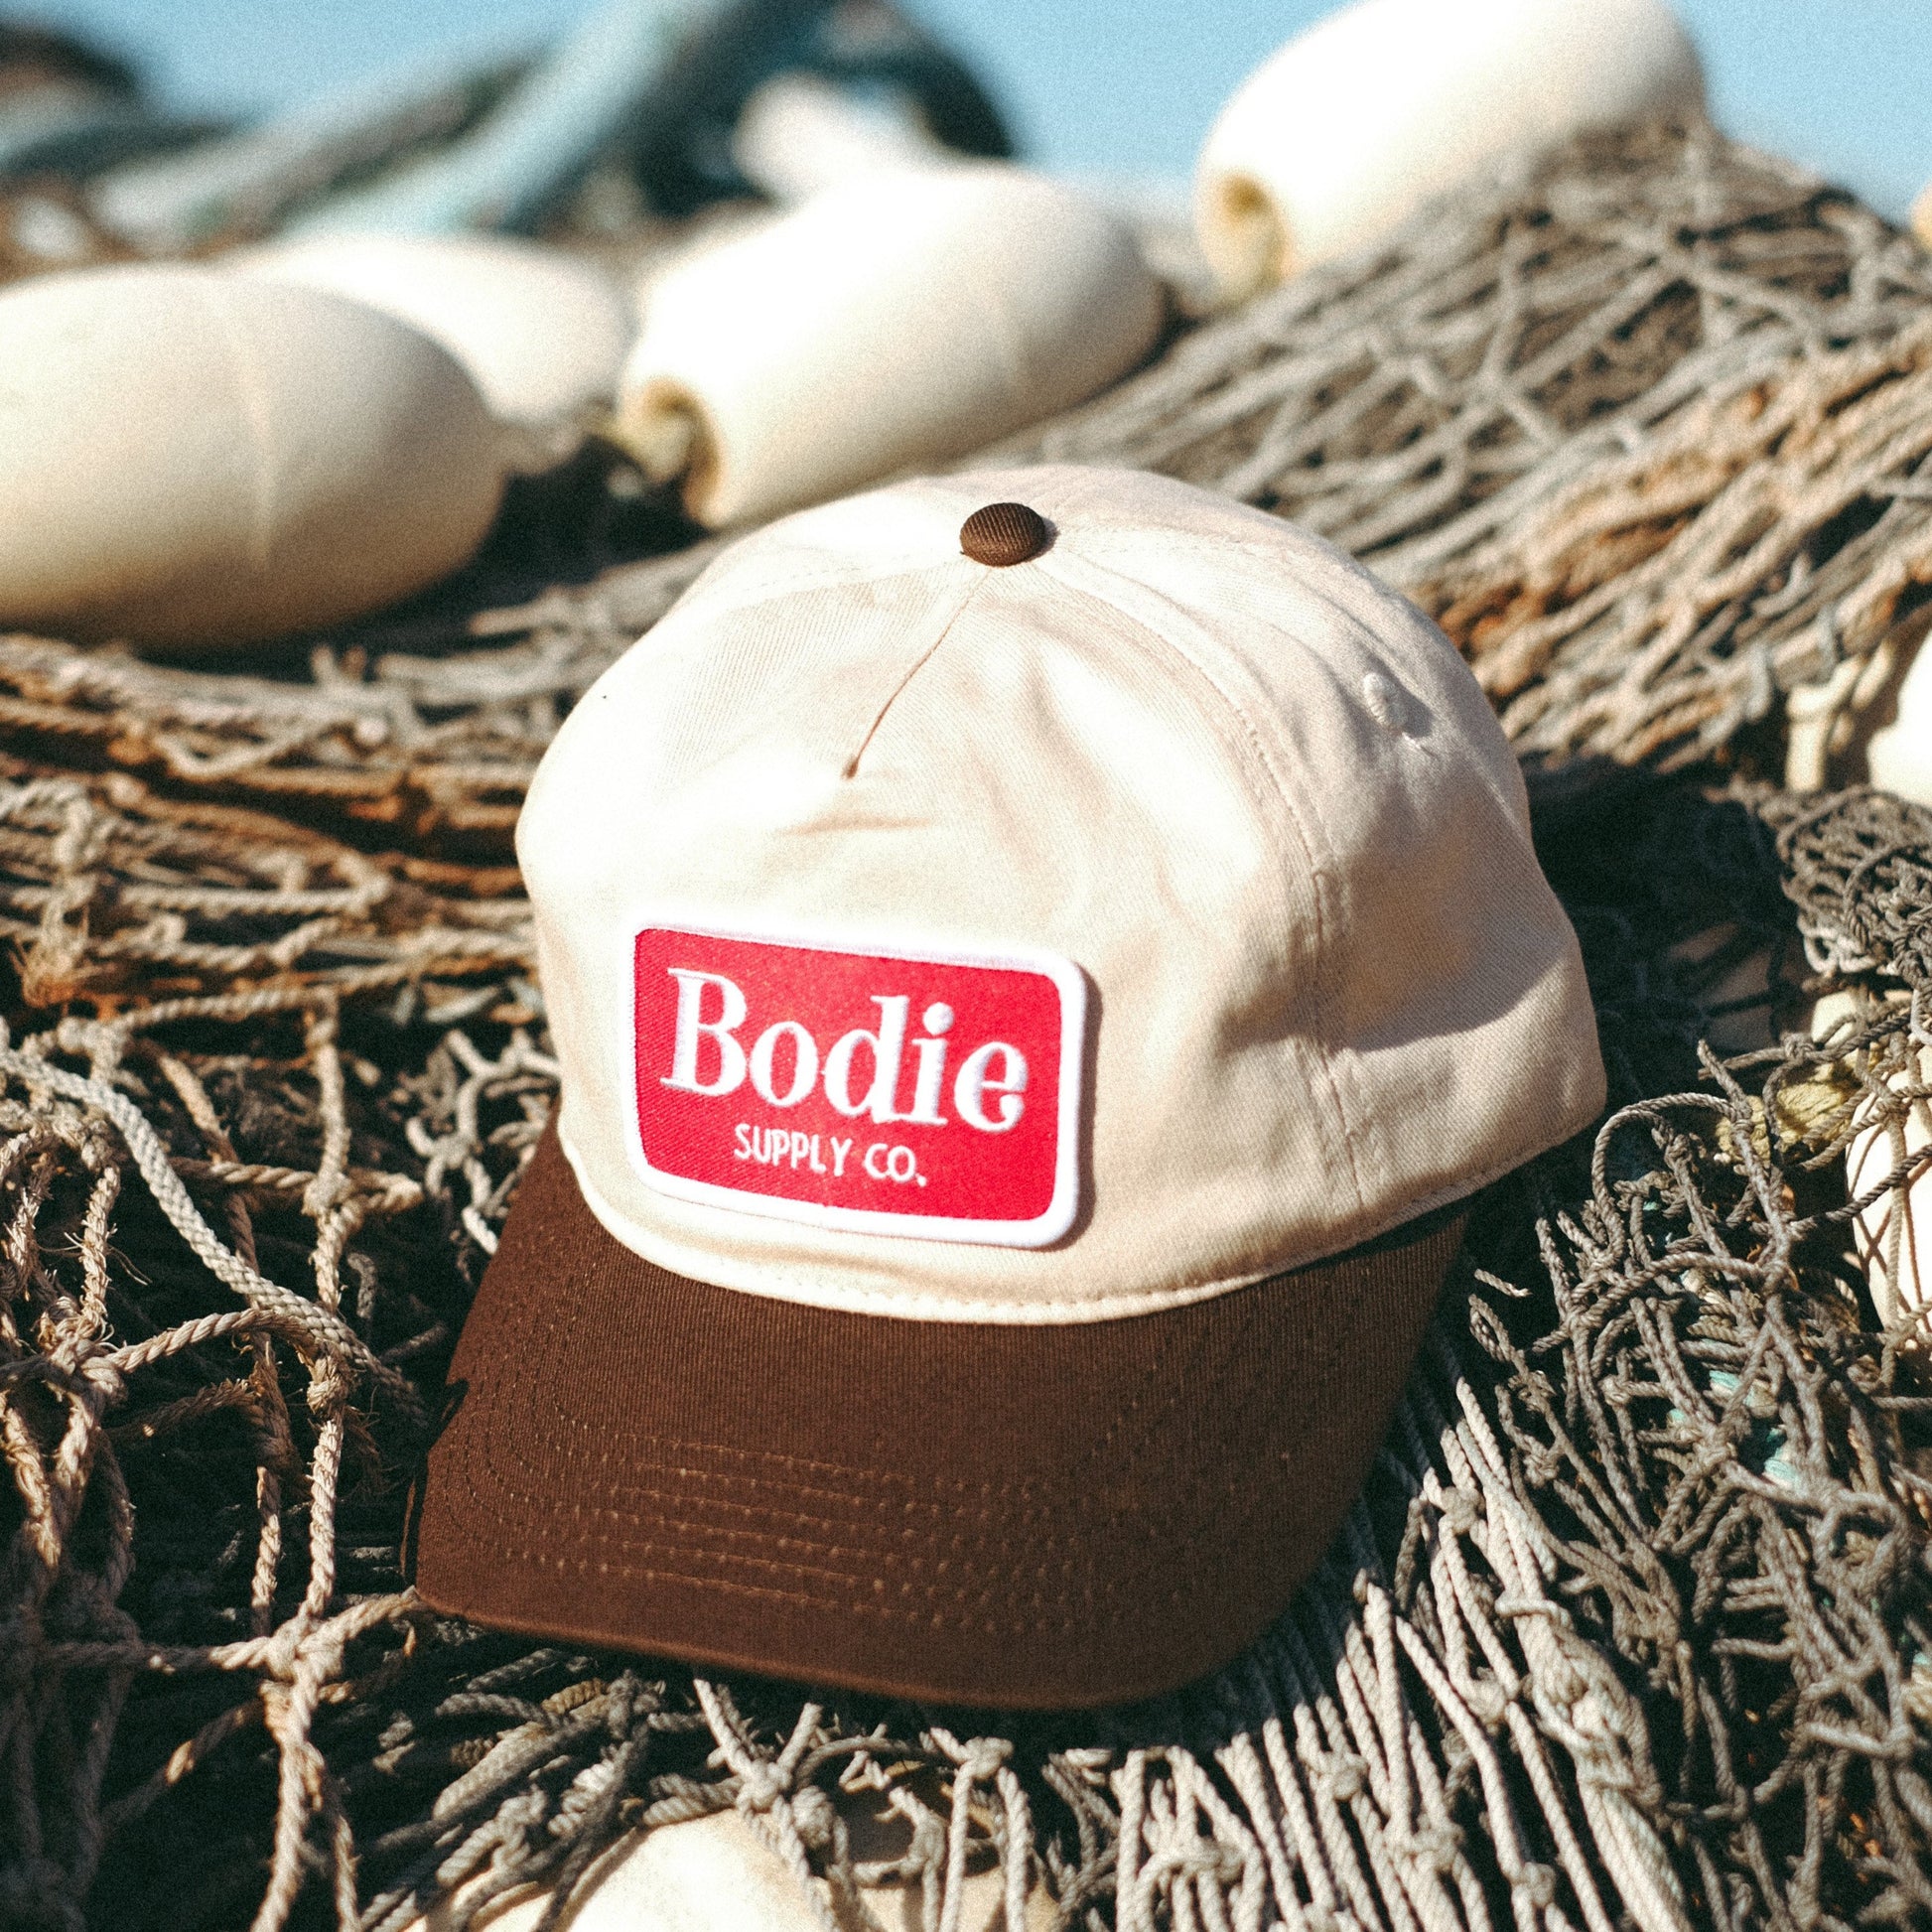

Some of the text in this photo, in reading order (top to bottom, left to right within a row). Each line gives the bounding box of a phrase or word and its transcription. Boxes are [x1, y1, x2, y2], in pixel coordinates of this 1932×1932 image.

[659, 967, 1029, 1133] Bodie
[733, 1122, 927, 1187] SUPPLY CO.
